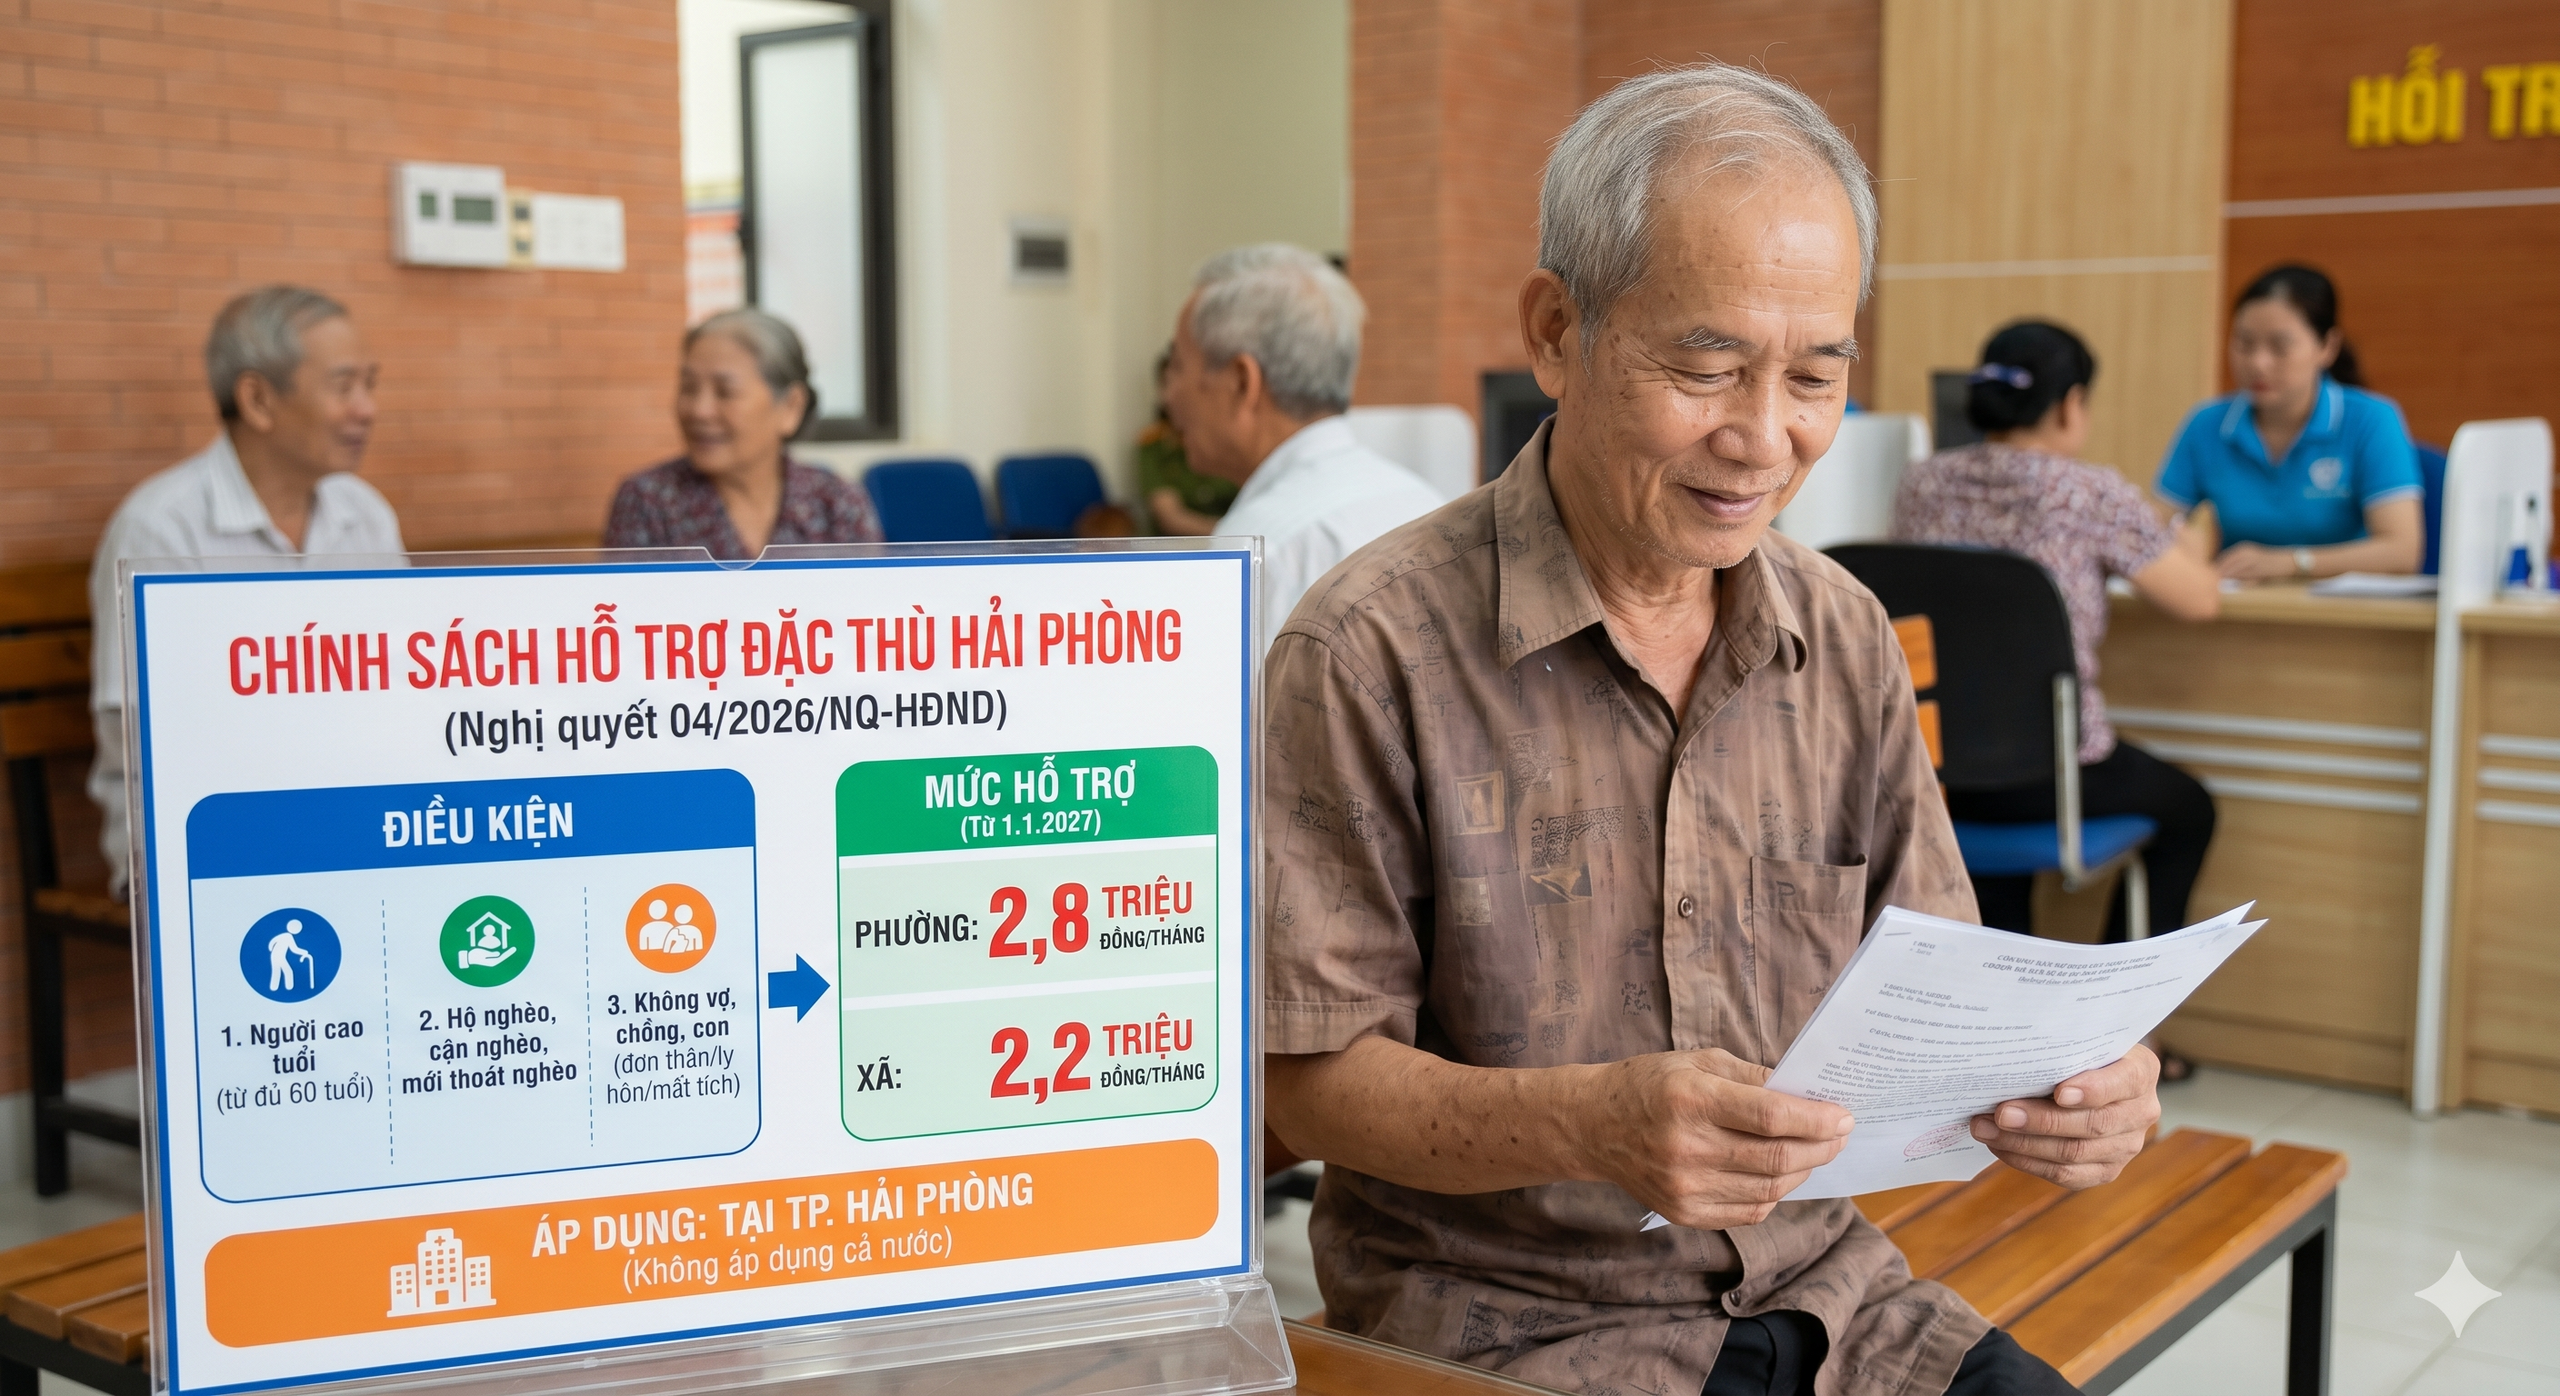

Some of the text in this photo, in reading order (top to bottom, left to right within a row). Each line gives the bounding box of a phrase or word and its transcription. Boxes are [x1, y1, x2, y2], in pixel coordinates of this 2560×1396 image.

[229, 595, 1182, 696] CHÍNH SÁCH HỖ TRỢ ĐẶC THÙ HẢI PHÒNG
[445, 689, 1007, 757] (Nghị quyết 04/2026/NQ-HĐND)
[925, 754, 1136, 809] MỨC HỖ TRỢ
[382, 794, 574, 848] ĐIỀU KIỆN
[960, 808, 1102, 844] (Từ 1.1.2027)
[855, 874, 1192, 965] PHƯỜNG: 2,8 TRIỆU
[1099, 925, 1205, 950] ĐỒNG/THÁNG
[419, 1001, 556, 1033] 2. Hộ nghèo,
[607, 987, 736, 1016] 3. Không vợ,
[221, 1019, 364, 1050] 1. Người cao
[429, 1032, 548, 1065] cận nghèo,
[616, 1017, 729, 1045] chồng, con
[272, 1044, 316, 1075] tuổi
[614, 1045, 734, 1080] (đơn thân/ly
[856, 1012, 1193, 1105] XÃ: 2,2 TRIỆU
[1100, 1062, 1205, 1088] ĐỒNG/THÁNG
[217, 1071, 374, 1116] (từ đủ 60 tuổi)
[402, 1059, 577, 1095] mới thoát nghèo
[607, 1072, 741, 1105] hôn/mất tích)
[531, 1170, 1033, 1258] ÁP DỤNG: TẠI TP. HẢI PHÒNG
[623, 1225, 953, 1294] (Không áp dụng cả nước)
